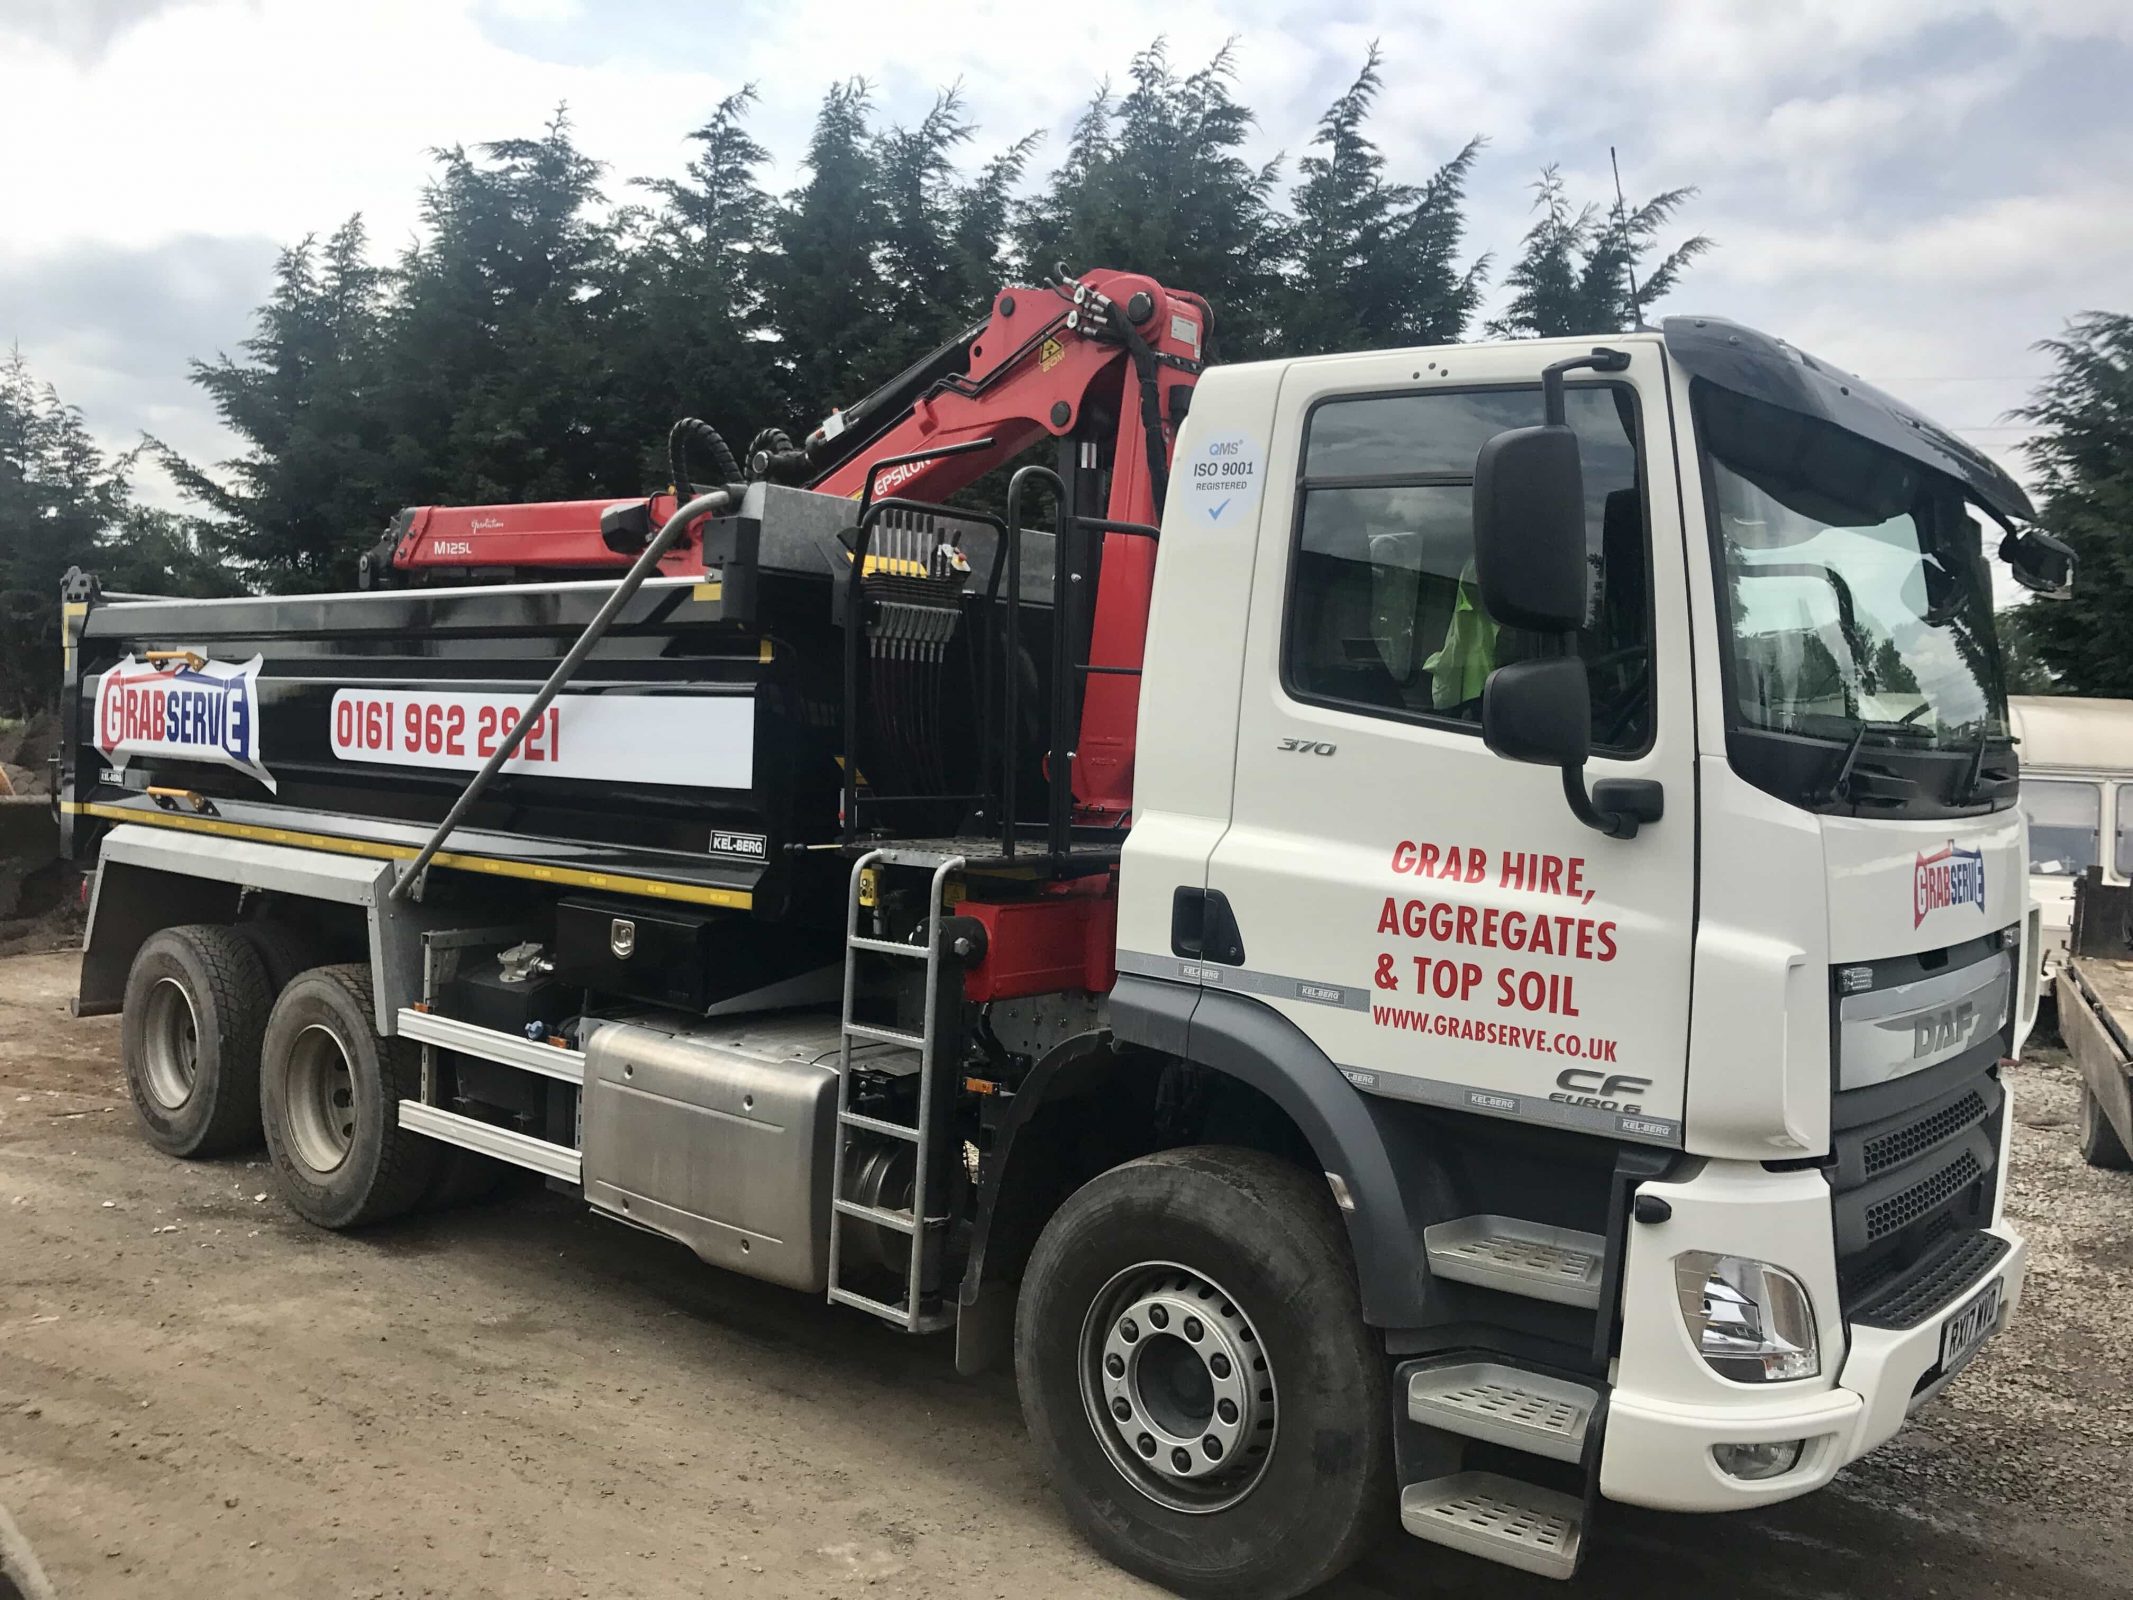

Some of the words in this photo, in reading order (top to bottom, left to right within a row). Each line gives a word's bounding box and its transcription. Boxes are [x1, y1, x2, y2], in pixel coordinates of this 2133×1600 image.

[1193, 462, 1218, 477] ISO
[1221, 461, 1254, 476] 9001
[1195, 481, 1248, 491] REGISTERED
[434, 541, 472, 555] M125L
[101, 678, 250, 761] GRABSERVE
[337, 699, 394, 751] 0161
[404, 703, 465, 756] 962
[1276, 737, 1337, 757] 370
[713, 835, 763, 854] KEL-BERG
[1391, 840, 1488, 884] GRAB
[1499, 851, 1596, 905] HIRE,
[1914, 855, 1985, 918] GRABSERVE
[1377, 897, 1618, 962] AGGREGATES
[1302, 986, 1340, 1000] KEL-BERG
[1374, 953, 1399, 991] &
[1413, 956, 1483, 1001] TOP
[1497, 968, 1580, 1017] SOIL
[1372, 1005, 1618, 1063] WWW.GRABSERVE.CO.UK
[1913, 1001, 1973, 1059] DAF
[1556, 1068, 1653, 1098] CF
[1471, 1093, 1514, 1109] KEL-BERG
[1549, 1092, 1619, 1113] EURO
[1623, 1103, 1642, 1115] 6
[1622, 1120, 1670, 1135] KEL-BERG
